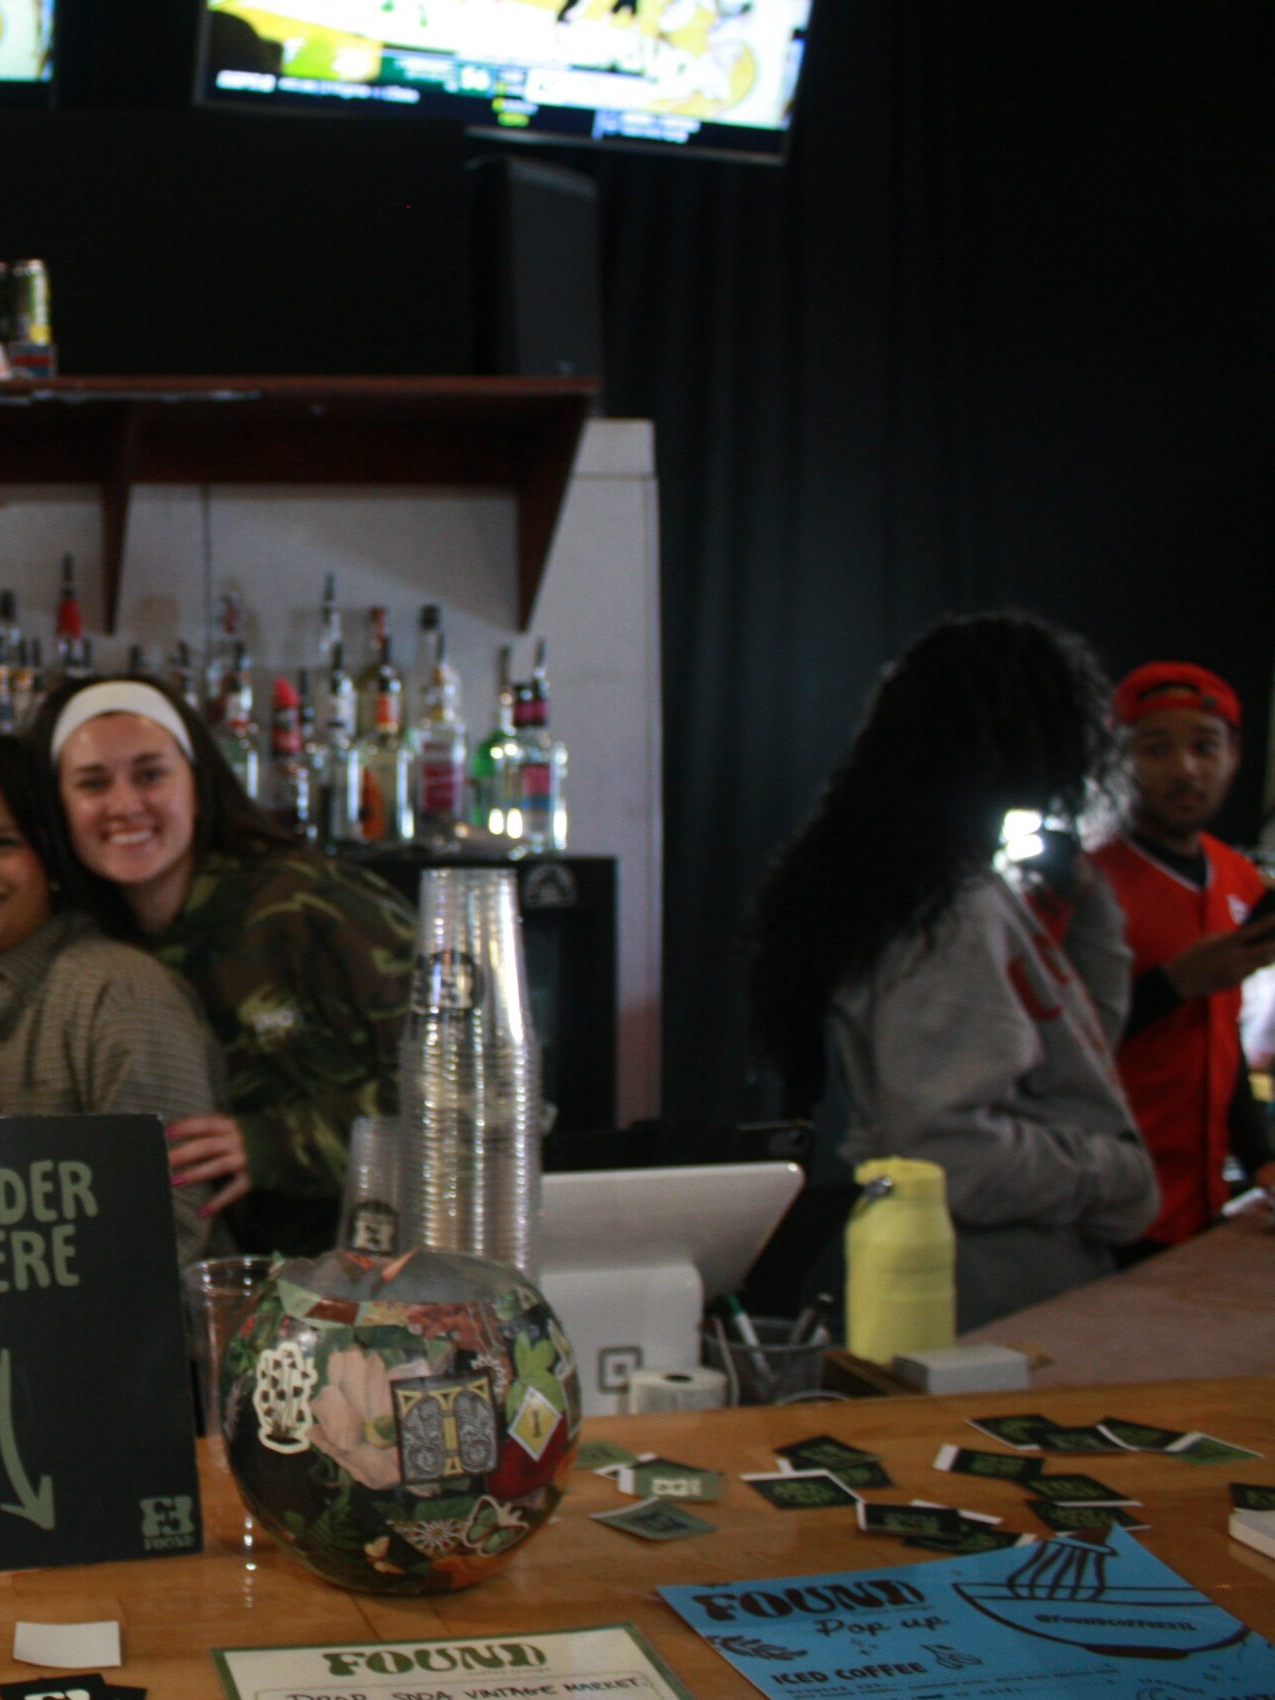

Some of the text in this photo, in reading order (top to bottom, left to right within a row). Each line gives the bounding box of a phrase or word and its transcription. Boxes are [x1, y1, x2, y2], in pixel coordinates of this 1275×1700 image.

[692, 1579, 927, 1621] FOUND
[814, 1617, 891, 1637] Pop
[322, 1643, 547, 1676] FOUND
[771, 1670, 829, 1685] ICED
[835, 1661, 928, 1681] COFFEE
[464, 1684, 559, 1700] VINTAGE
